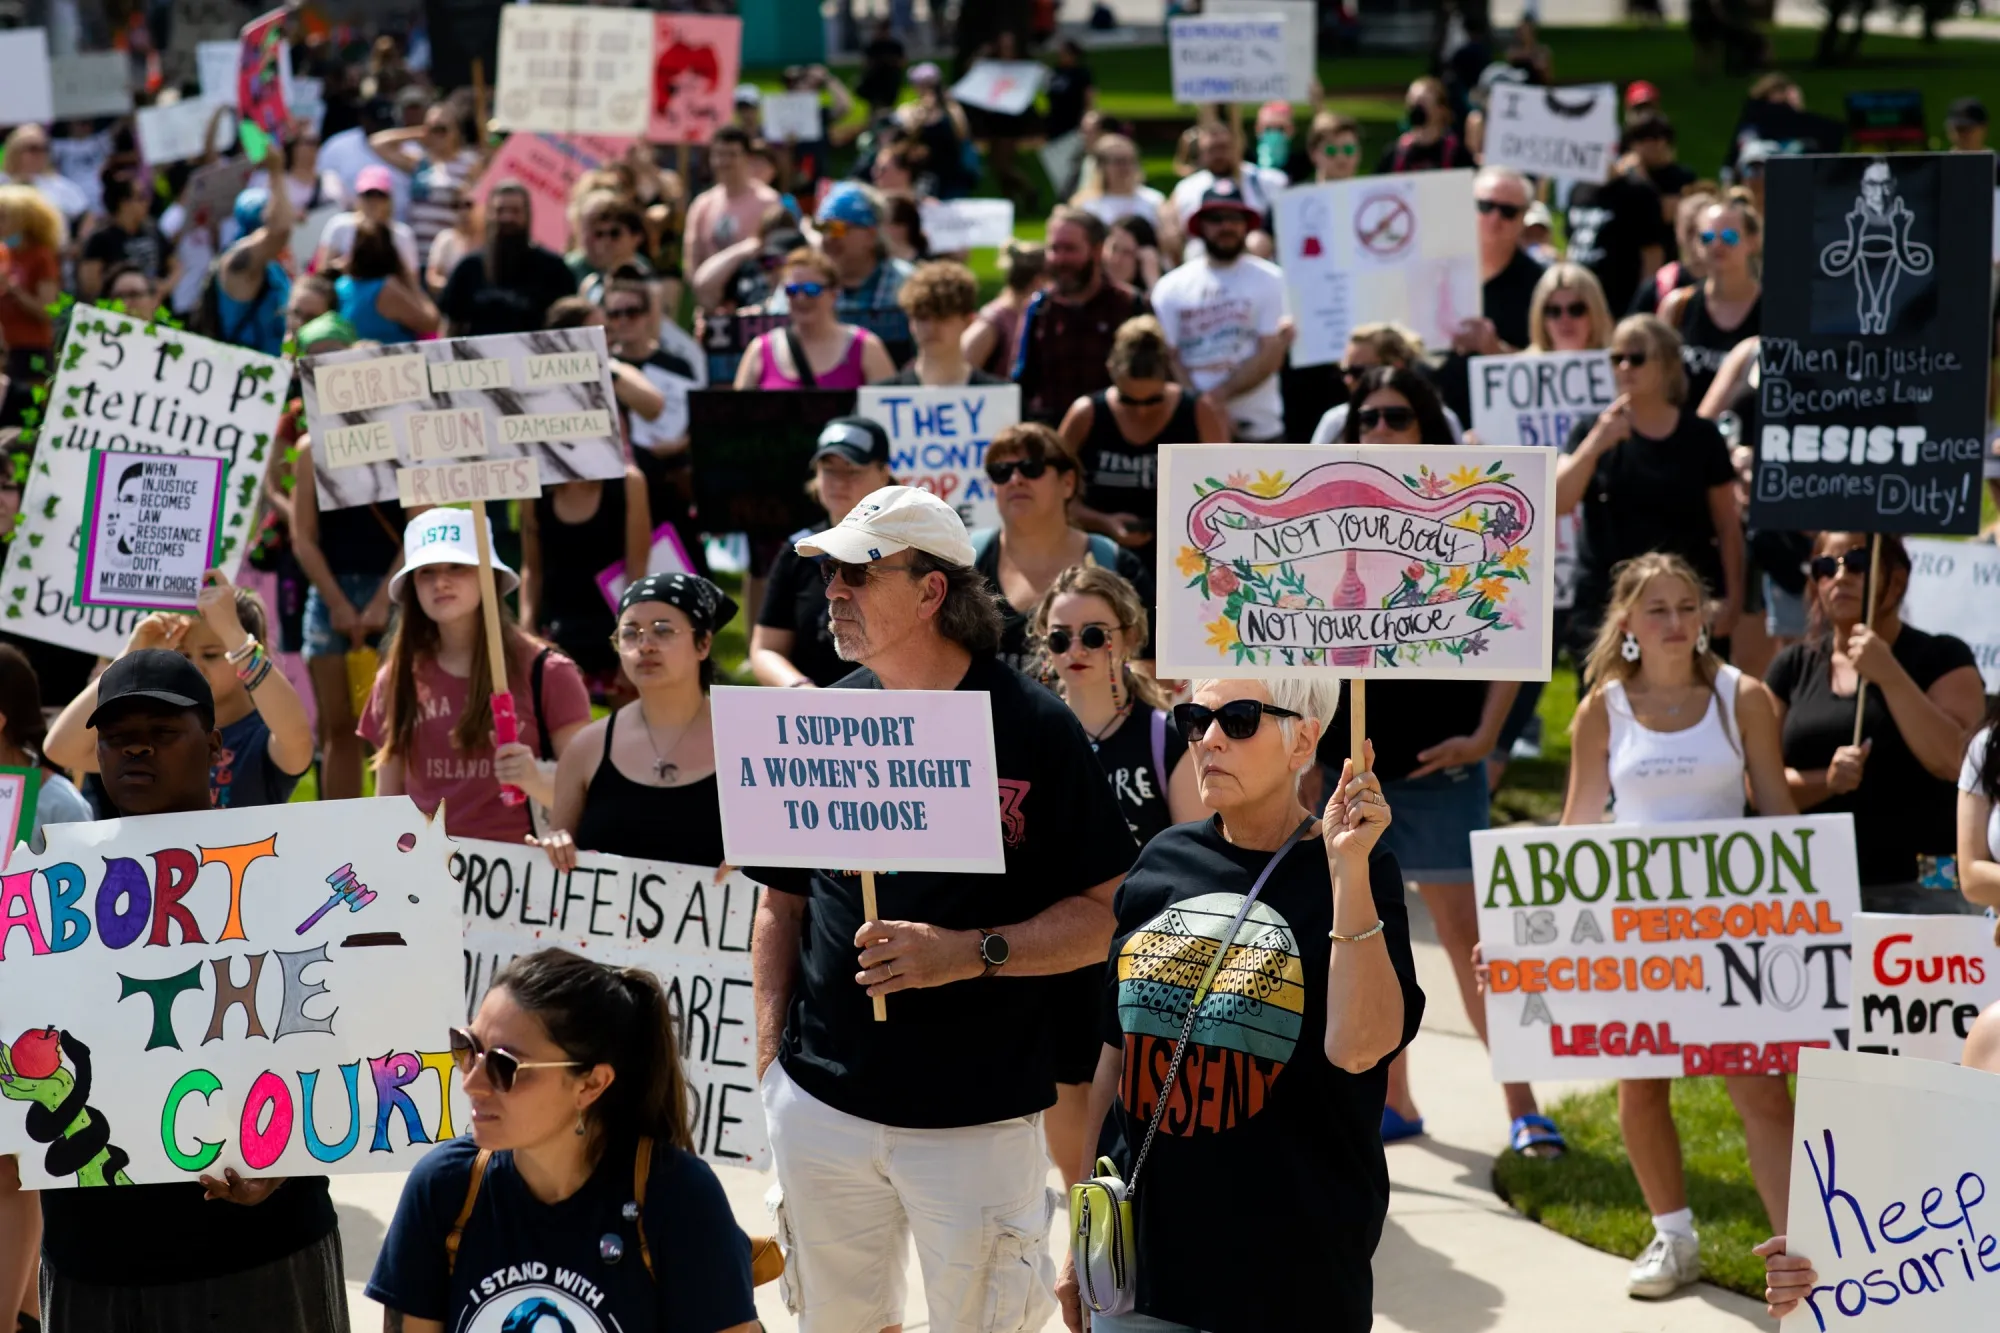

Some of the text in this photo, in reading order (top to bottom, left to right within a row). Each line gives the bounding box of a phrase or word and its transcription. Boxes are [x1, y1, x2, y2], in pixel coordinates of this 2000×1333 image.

[1504, 91, 1522, 120] I
[1501, 132, 1604, 171] DISSENT
[440, 359, 504, 389] JUST
[528, 355, 595, 380] WANNA
[1758, 338, 1838, 376] When
[879, 395, 986, 438] THEY
[1761, 377, 1934, 417] Becomes Law
[81, 380, 244, 470] telling
[326, 411, 605, 462] HAVE FUN DAMENTAL
[1761, 424, 1981, 466] RESISTence
[142, 478, 198, 495] INJUSTICE
[145, 462, 177, 477] WHEN
[411, 459, 530, 504] RIGHTS
[140, 493, 192, 510] BECOMES
[1757, 462, 1971, 527] Becomes Duty!
[136, 525, 202, 542] RESISTANCE
[138, 509, 162, 523] LAW
[421, 525, 461, 546] 1973
[134, 541, 185, 557] BECOMES
[1254, 517, 1320, 560] NOT
[1326, 512, 1399, 548] YOUR
[101, 571, 198, 592] MY BODY MY CHOICE
[132, 557, 162, 572] DUTY.
[1247, 608, 1304, 642] NOT
[1307, 613, 1371, 645] YOUR
[776, 715, 915, 746] I SUPPORT
[426, 757, 491, 779] ISLAND
[740, 757, 972, 788] A WOMEN'S RIGHT
[784, 800, 928, 831] TO CHOOSE
[1483, 829, 1820, 909] ABORTION
[0, 832, 279, 962] ABORT
[625, 872, 667, 939] IS
[1513, 900, 1843, 946] IS A PERSONAL
[1716, 941, 1852, 1012] NOT
[1872, 933, 1986, 986] Guns
[116, 941, 340, 1053] THE
[1520, 993, 1554, 1027] A
[1550, 1020, 1680, 1058] LEGAL
[1803, 1128, 1986, 1260] Keep
[469, 1261, 605, 1309] I STAND WITH
